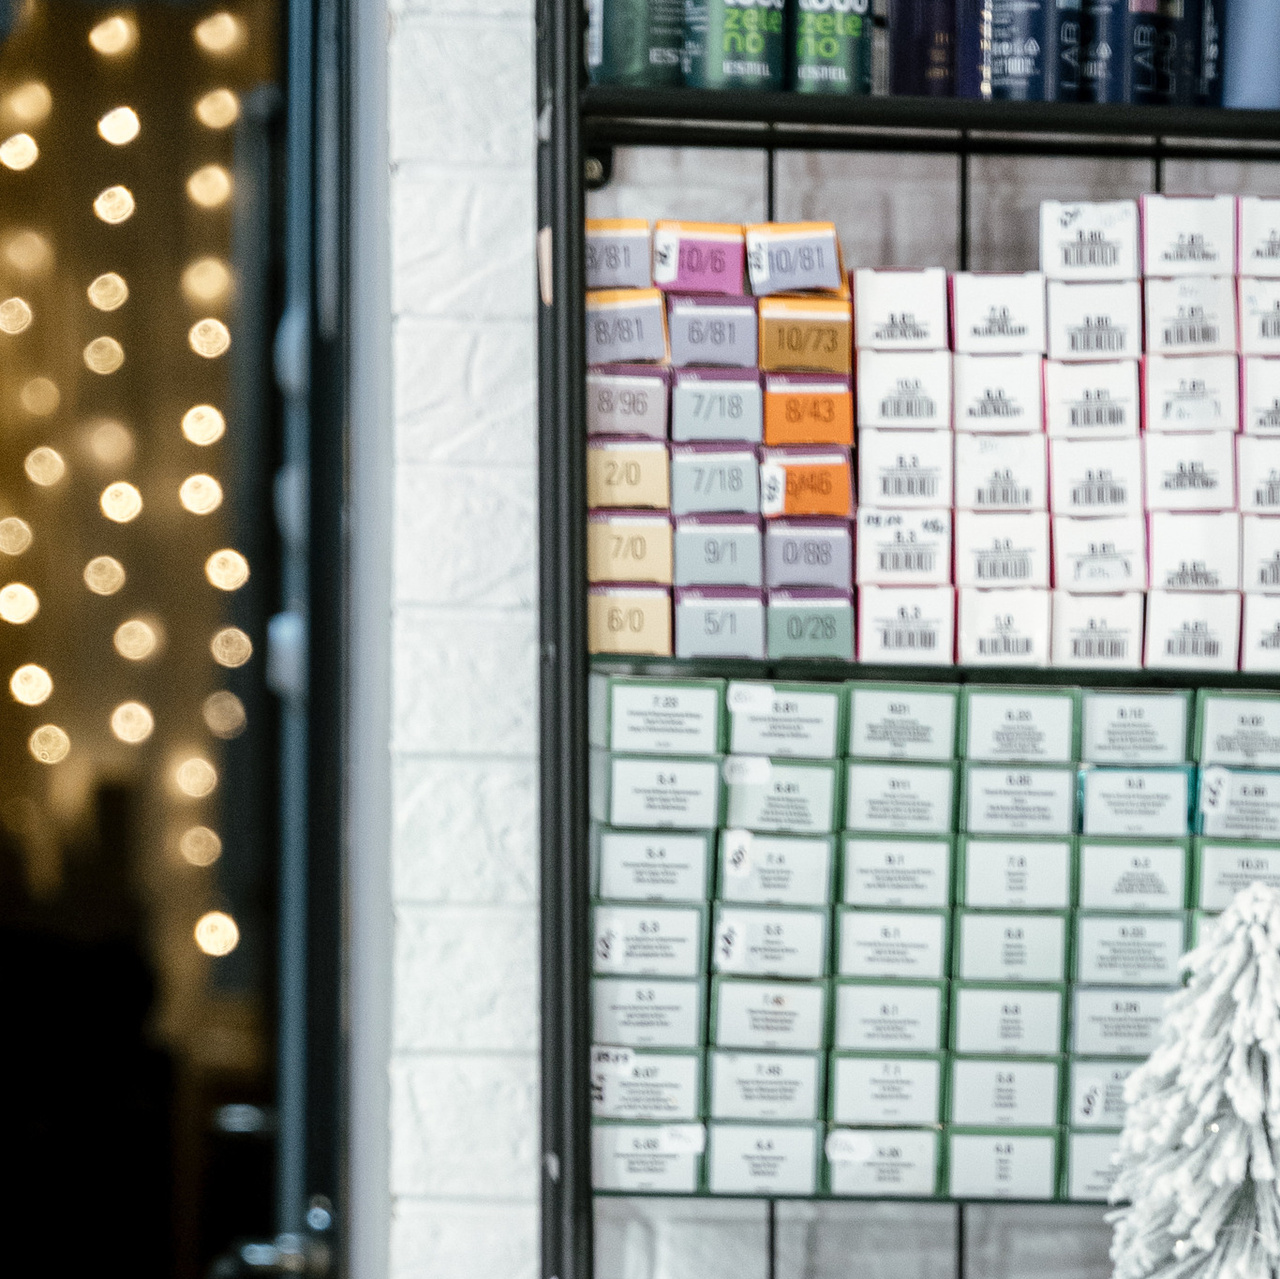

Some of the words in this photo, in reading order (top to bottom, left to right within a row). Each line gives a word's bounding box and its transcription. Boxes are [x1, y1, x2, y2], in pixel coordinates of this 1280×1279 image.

[688, 320, 737, 345] 6/81
[778, 328, 838, 353] 10/73
[692, 394, 744, 421] 7/18
[785, 398, 836, 423] 8/43
[605, 460, 641, 487] 2/0
[694, 467, 744, 494] 7/18
[609, 535, 647, 560] 7/0
[704, 539, 738, 565] 9/1
[608, 608, 645, 633] 6/0
[704, 611, 738, 636] 5/1
[786, 616, 837, 640] 0/28
